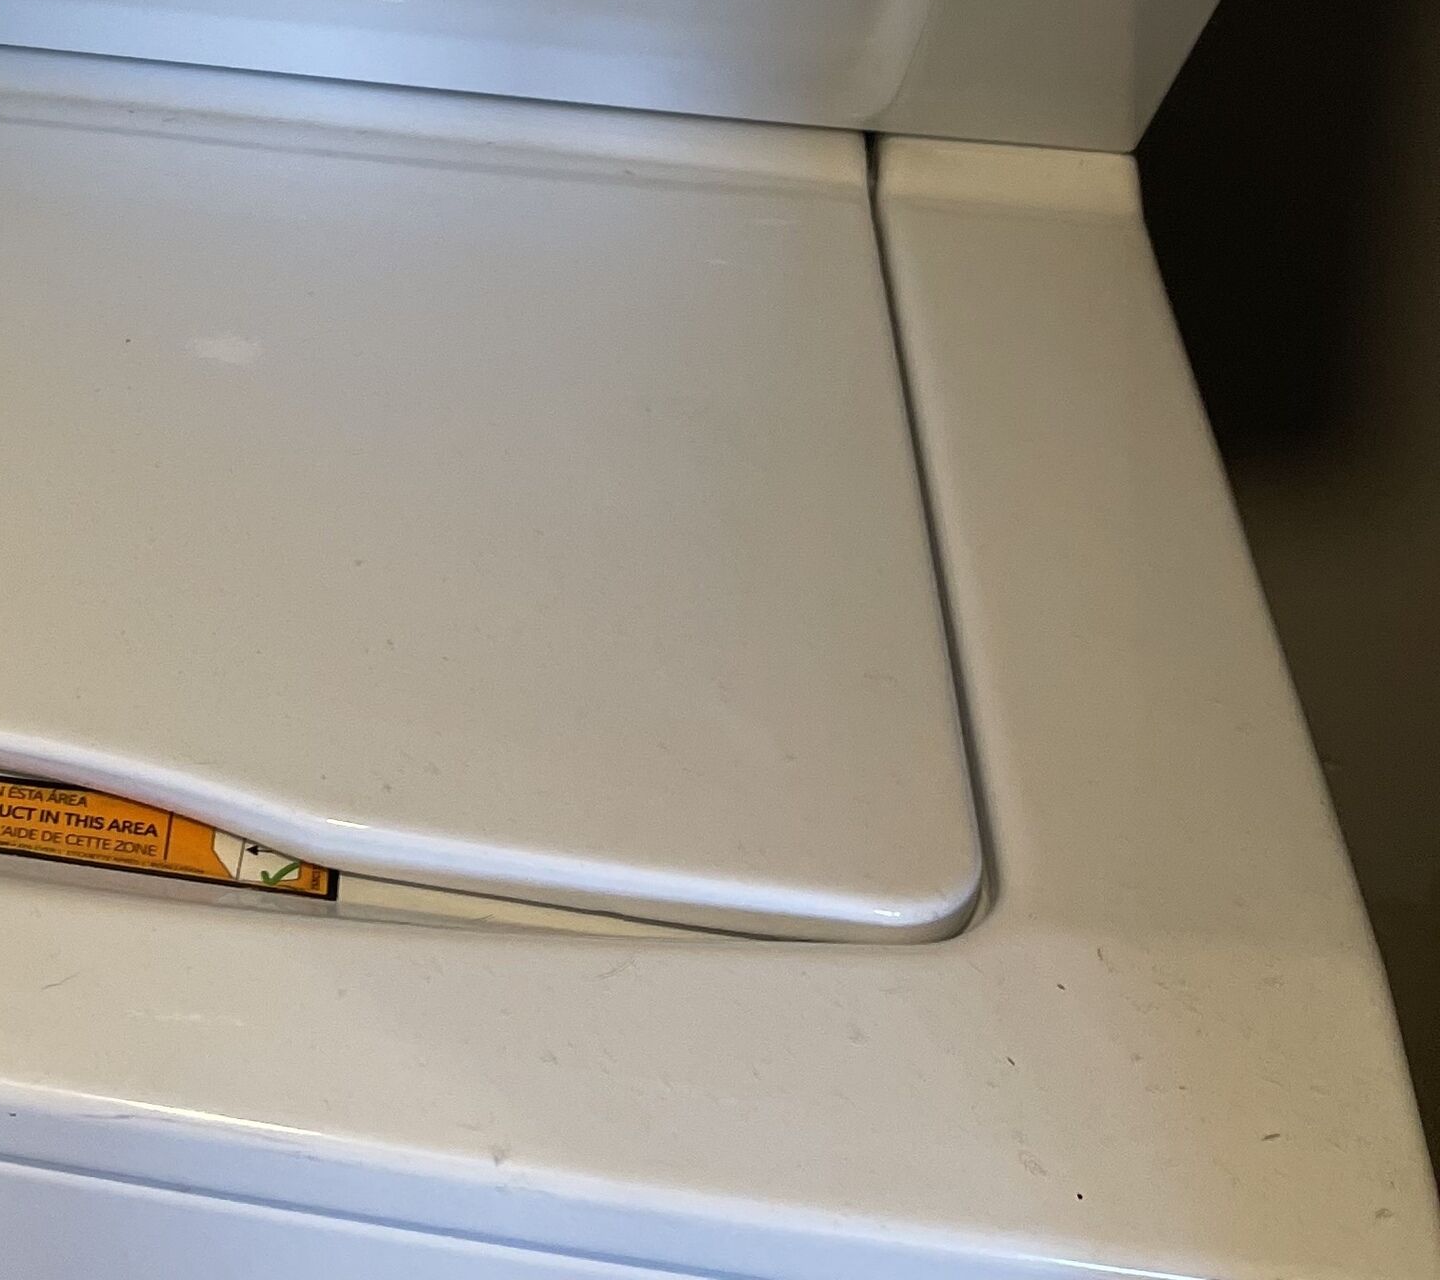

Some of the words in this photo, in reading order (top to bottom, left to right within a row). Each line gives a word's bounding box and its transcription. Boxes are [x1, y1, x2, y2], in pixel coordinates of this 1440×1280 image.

[7, 786, 43, 801] ESTA
[39, 809, 59, 824] IN
[65, 812, 104, 830] THIS
[107, 819, 158, 837] AREA
